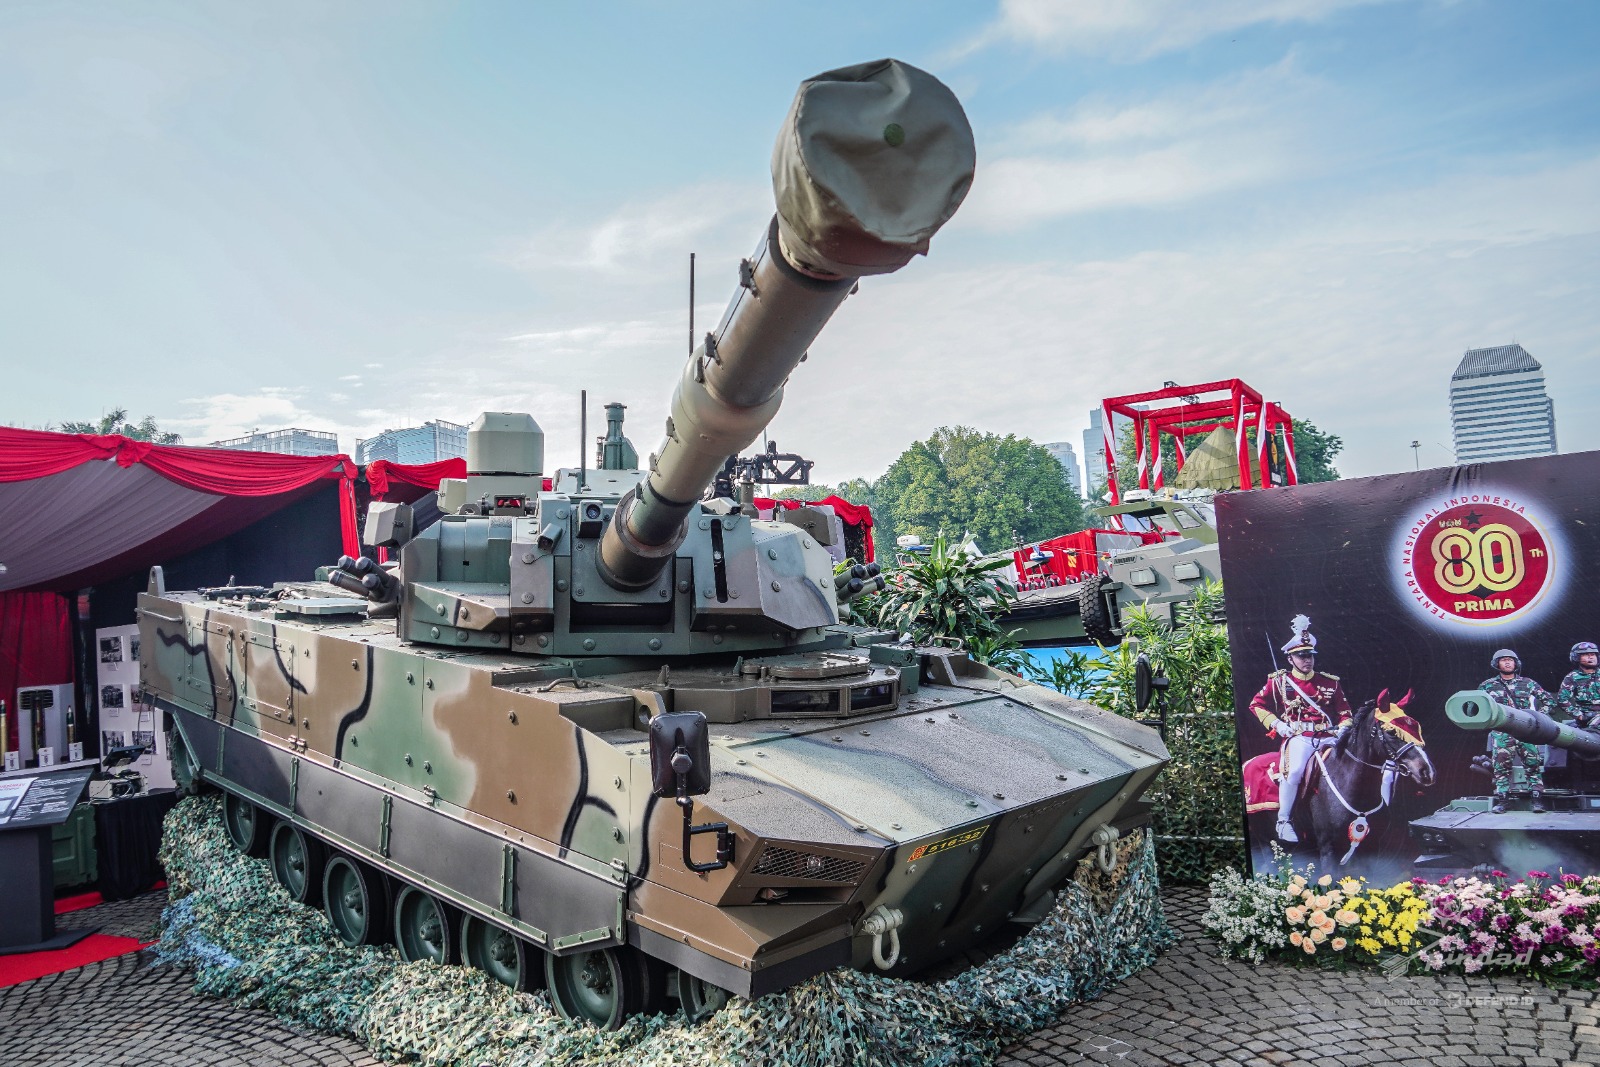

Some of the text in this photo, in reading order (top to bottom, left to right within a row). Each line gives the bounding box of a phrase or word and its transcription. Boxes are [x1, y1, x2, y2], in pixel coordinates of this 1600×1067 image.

[1444, 494, 1526, 514] INDONESIA
[1402, 508, 1440, 564] NASIONAL
[1431, 523, 1526, 595] 80
[1404, 571, 1446, 620] TENTARA
[1454, 598, 1515, 613] PRIMA
